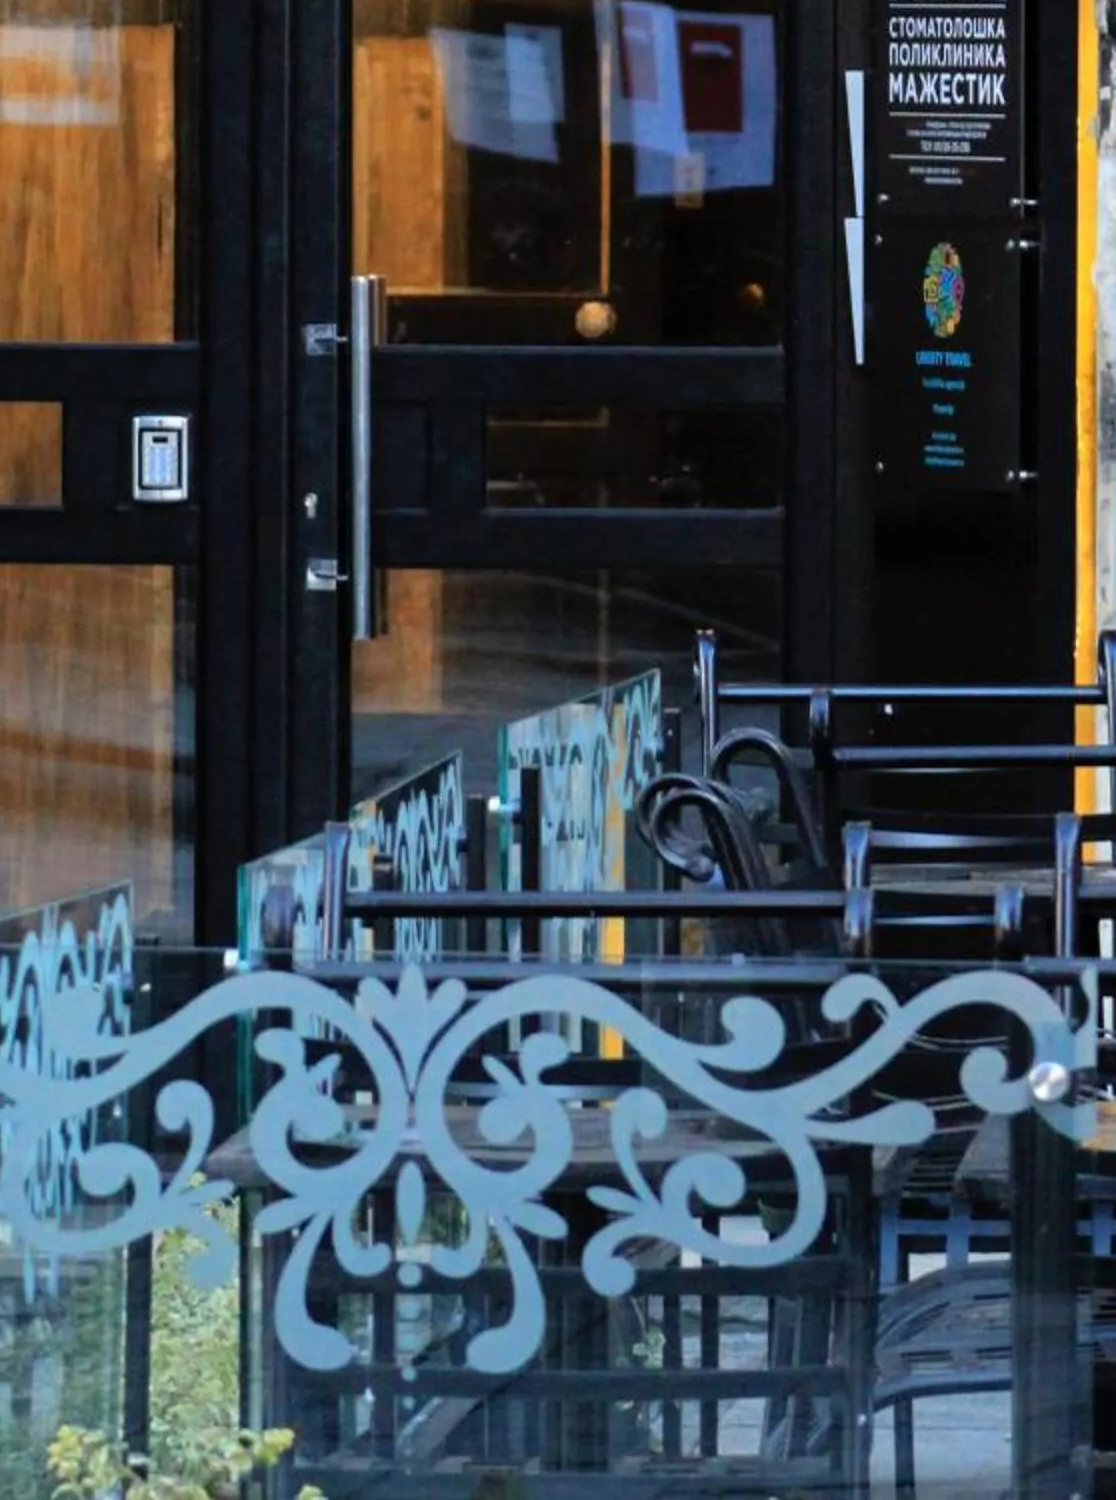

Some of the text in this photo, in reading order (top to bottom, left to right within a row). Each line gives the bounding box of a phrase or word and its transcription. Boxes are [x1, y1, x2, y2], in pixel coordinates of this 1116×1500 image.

[889, 16, 1006, 39] СТОМАТОЛОШКА
[889, 43, 1006, 68] ПОЛИКЛИНИКА
[889, 72, 1006, 106] МАЖЕСТИК
